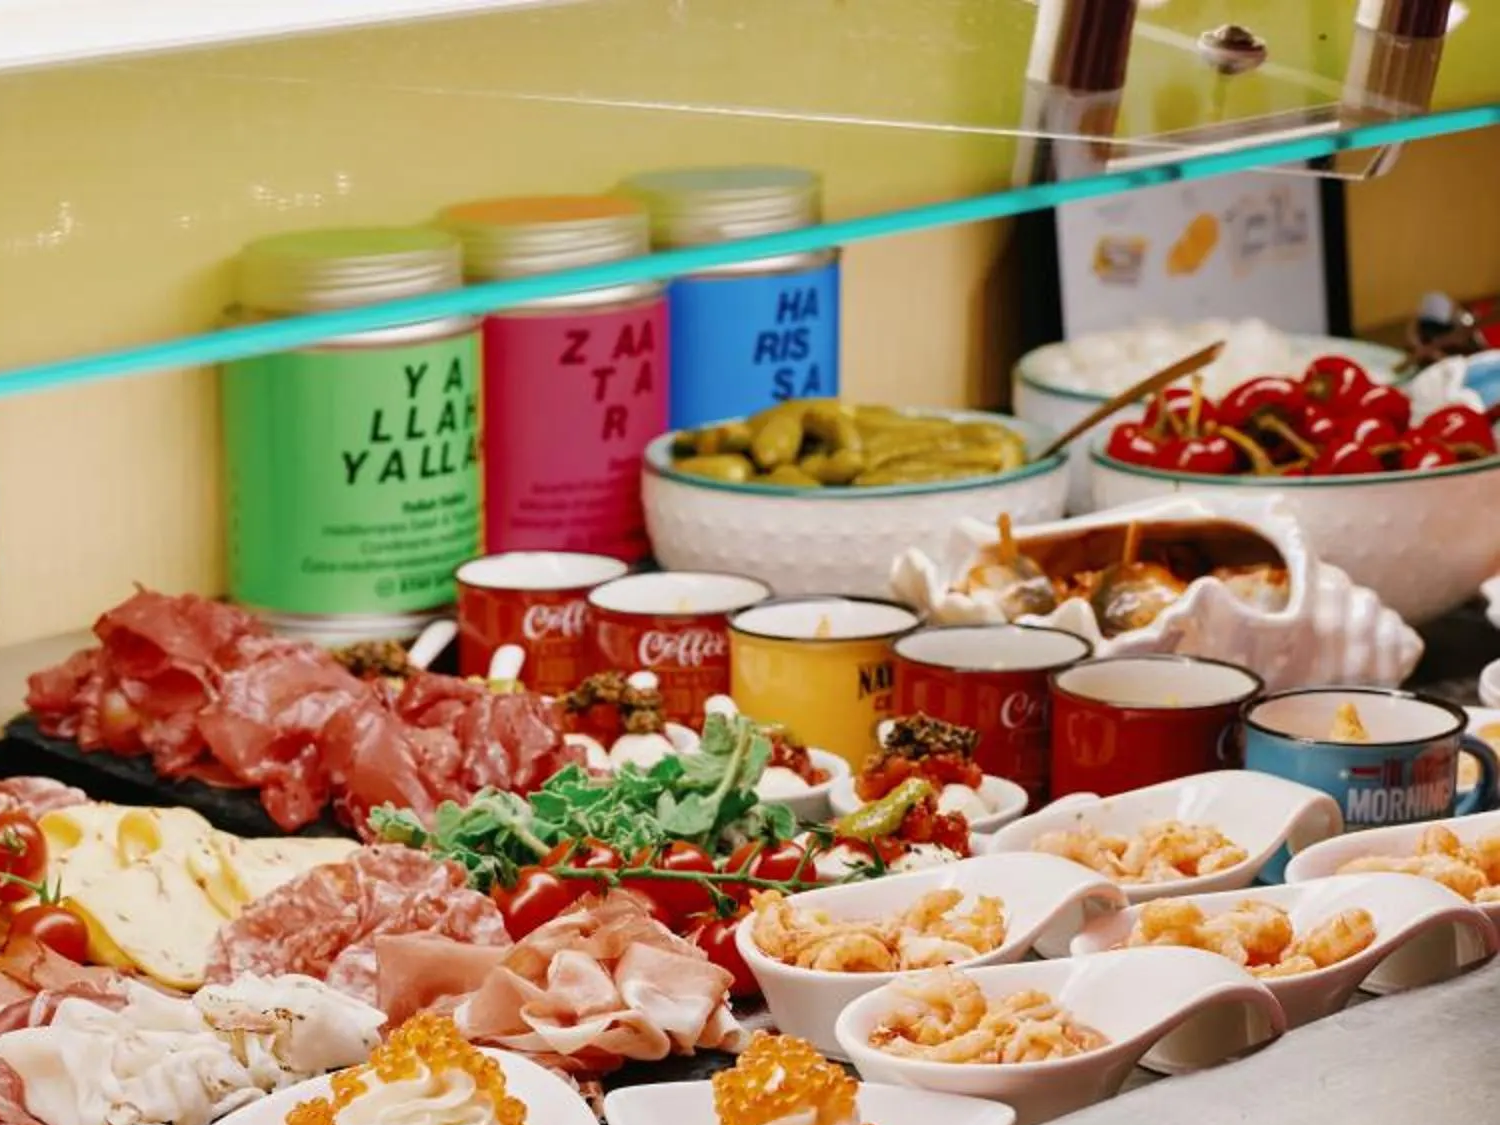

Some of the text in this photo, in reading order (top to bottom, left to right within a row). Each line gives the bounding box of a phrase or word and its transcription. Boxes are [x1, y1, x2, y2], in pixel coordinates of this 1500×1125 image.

[776, 287, 819, 324] HA
[753, 328, 810, 365] RIS
[602, 405, 628, 442] R
[523, 600, 590, 640] Coff
